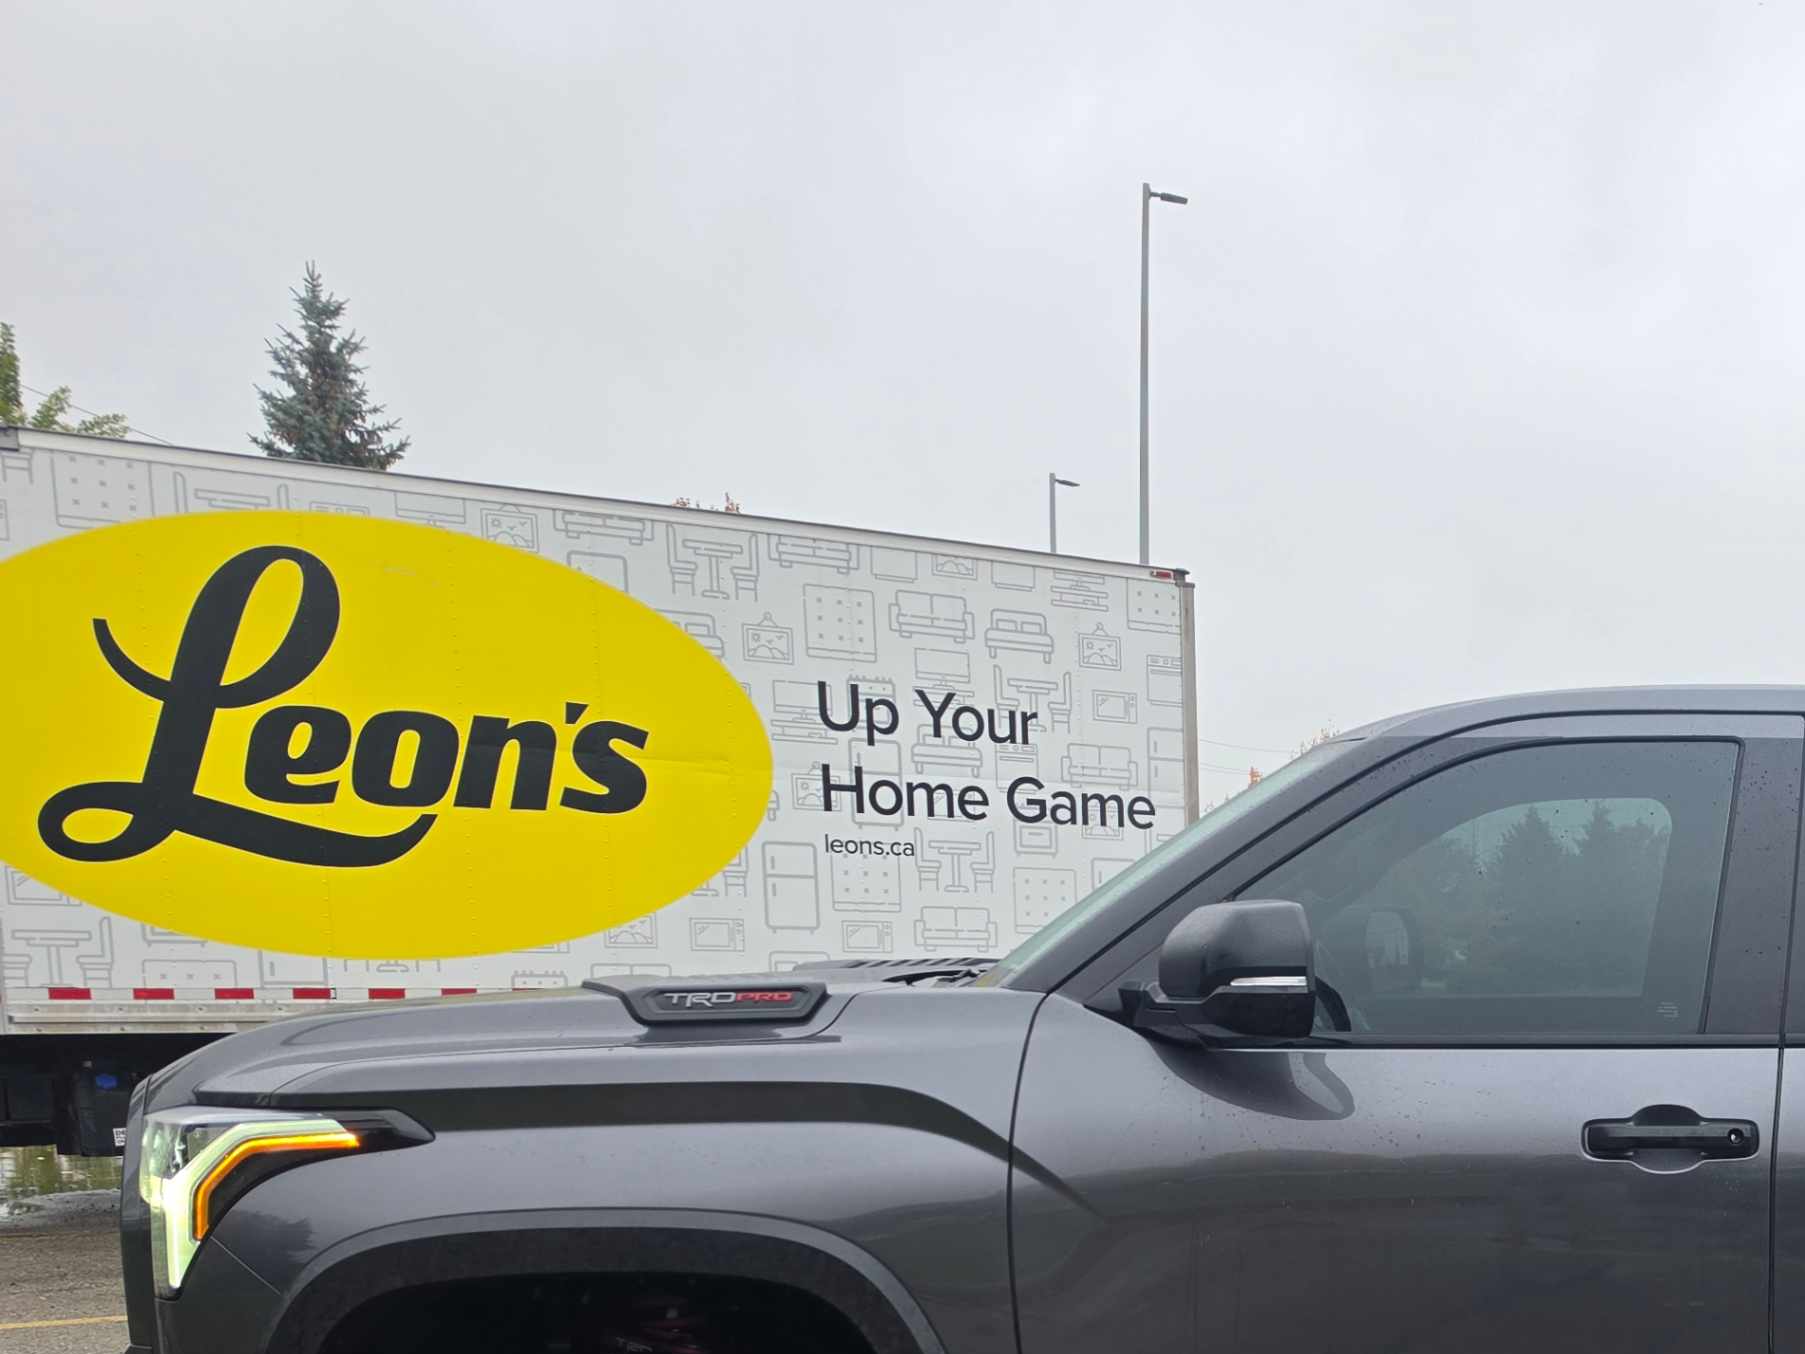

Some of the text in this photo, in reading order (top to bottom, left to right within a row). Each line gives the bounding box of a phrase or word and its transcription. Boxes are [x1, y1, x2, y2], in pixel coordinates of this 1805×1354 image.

[37, 545, 649, 868] Leon's
[816, 680, 1039, 746] Up Your
[820, 763, 1156, 830] Home Game
[824, 834, 916, 857] leons.ca
[663, 991, 793, 1008] TRD PRO
